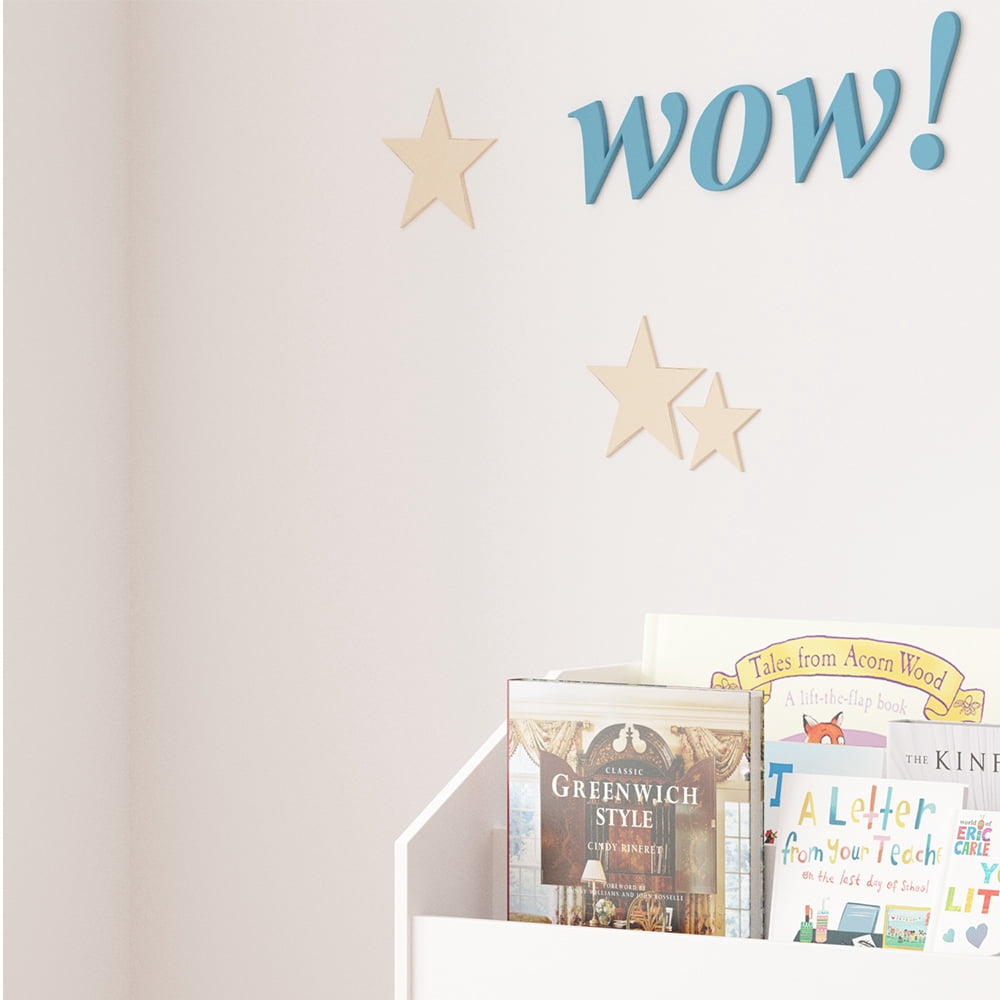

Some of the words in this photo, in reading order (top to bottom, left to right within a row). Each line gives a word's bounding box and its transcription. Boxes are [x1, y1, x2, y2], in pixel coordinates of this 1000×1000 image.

[568, 11, 962, 205] wow!
[749, 653, 792, 679] Tales
[798, 646, 836, 668] from
[844, 645, 894, 673] Acorn
[900, 651, 949, 691] Wood
[785, 692, 795, 707] A
[800, 688, 872, 712] lift-the-flap
[877, 693, 908, 715] book
[605, 767, 644, 776] CLASSIC
[906, 754, 929, 764] THE
[552, 773, 698, 805] GREENWICH
[596, 807, 653, 829] STYLE
[798, 791, 817, 826] A
[828, 784, 937, 831] Letter
[587, 842, 618, 852] CINDY
[782, 831, 823, 865] from
[954, 840, 990, 856] CARLE
[802, 870, 814, 881] on
[818, 870, 834, 884] the
[840, 869, 860, 886] last
[867, 874, 882, 892] day
[887, 880, 898, 892] of
